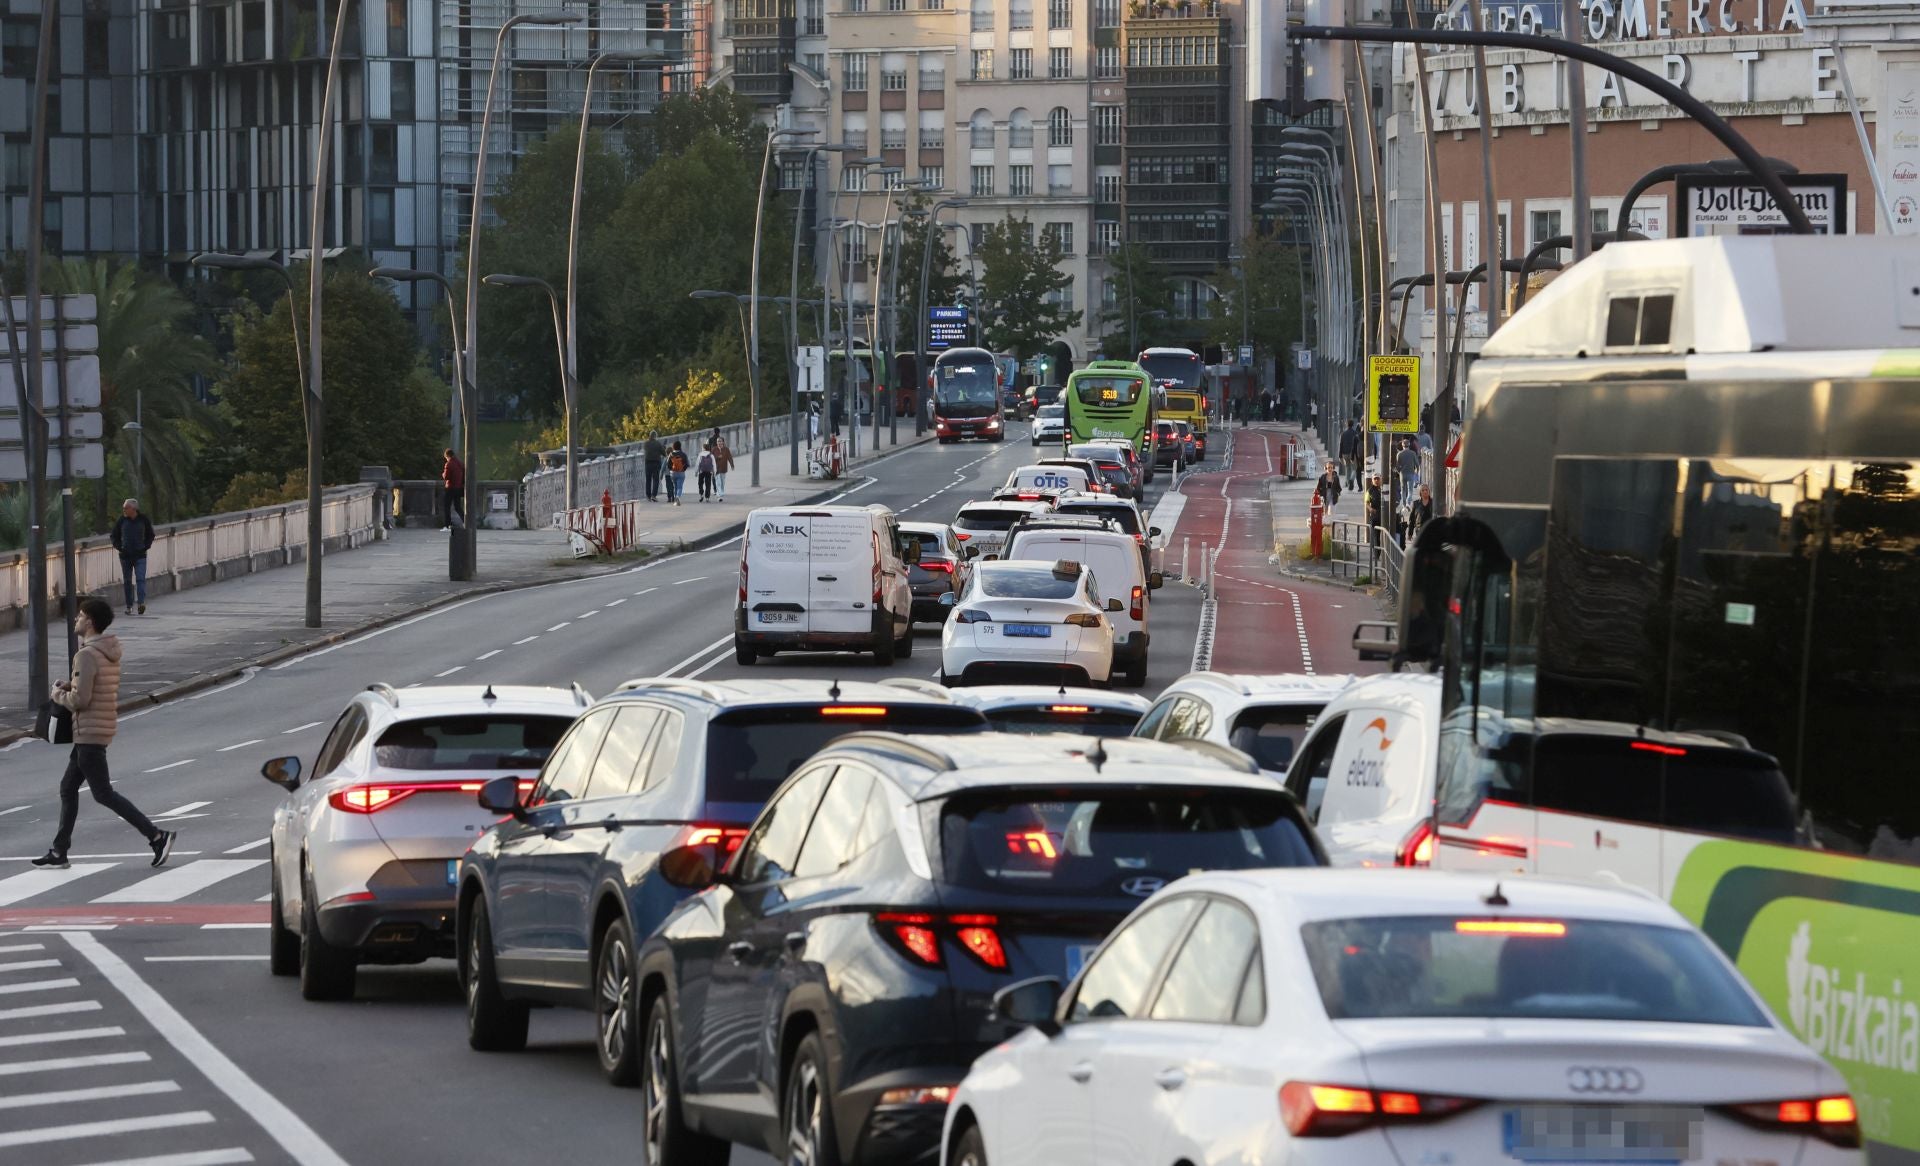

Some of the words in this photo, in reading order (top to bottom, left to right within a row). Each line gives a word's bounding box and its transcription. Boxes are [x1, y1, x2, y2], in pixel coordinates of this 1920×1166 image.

[1432, 49, 1840, 118] ZUBIARTE
[1696, 186, 1828, 213] Voll-Dam
[1033, 476, 1068, 489] OTIS
[775, 525, 808, 538] LBK
[1809, 964, 1919, 1072] Bizkaia
